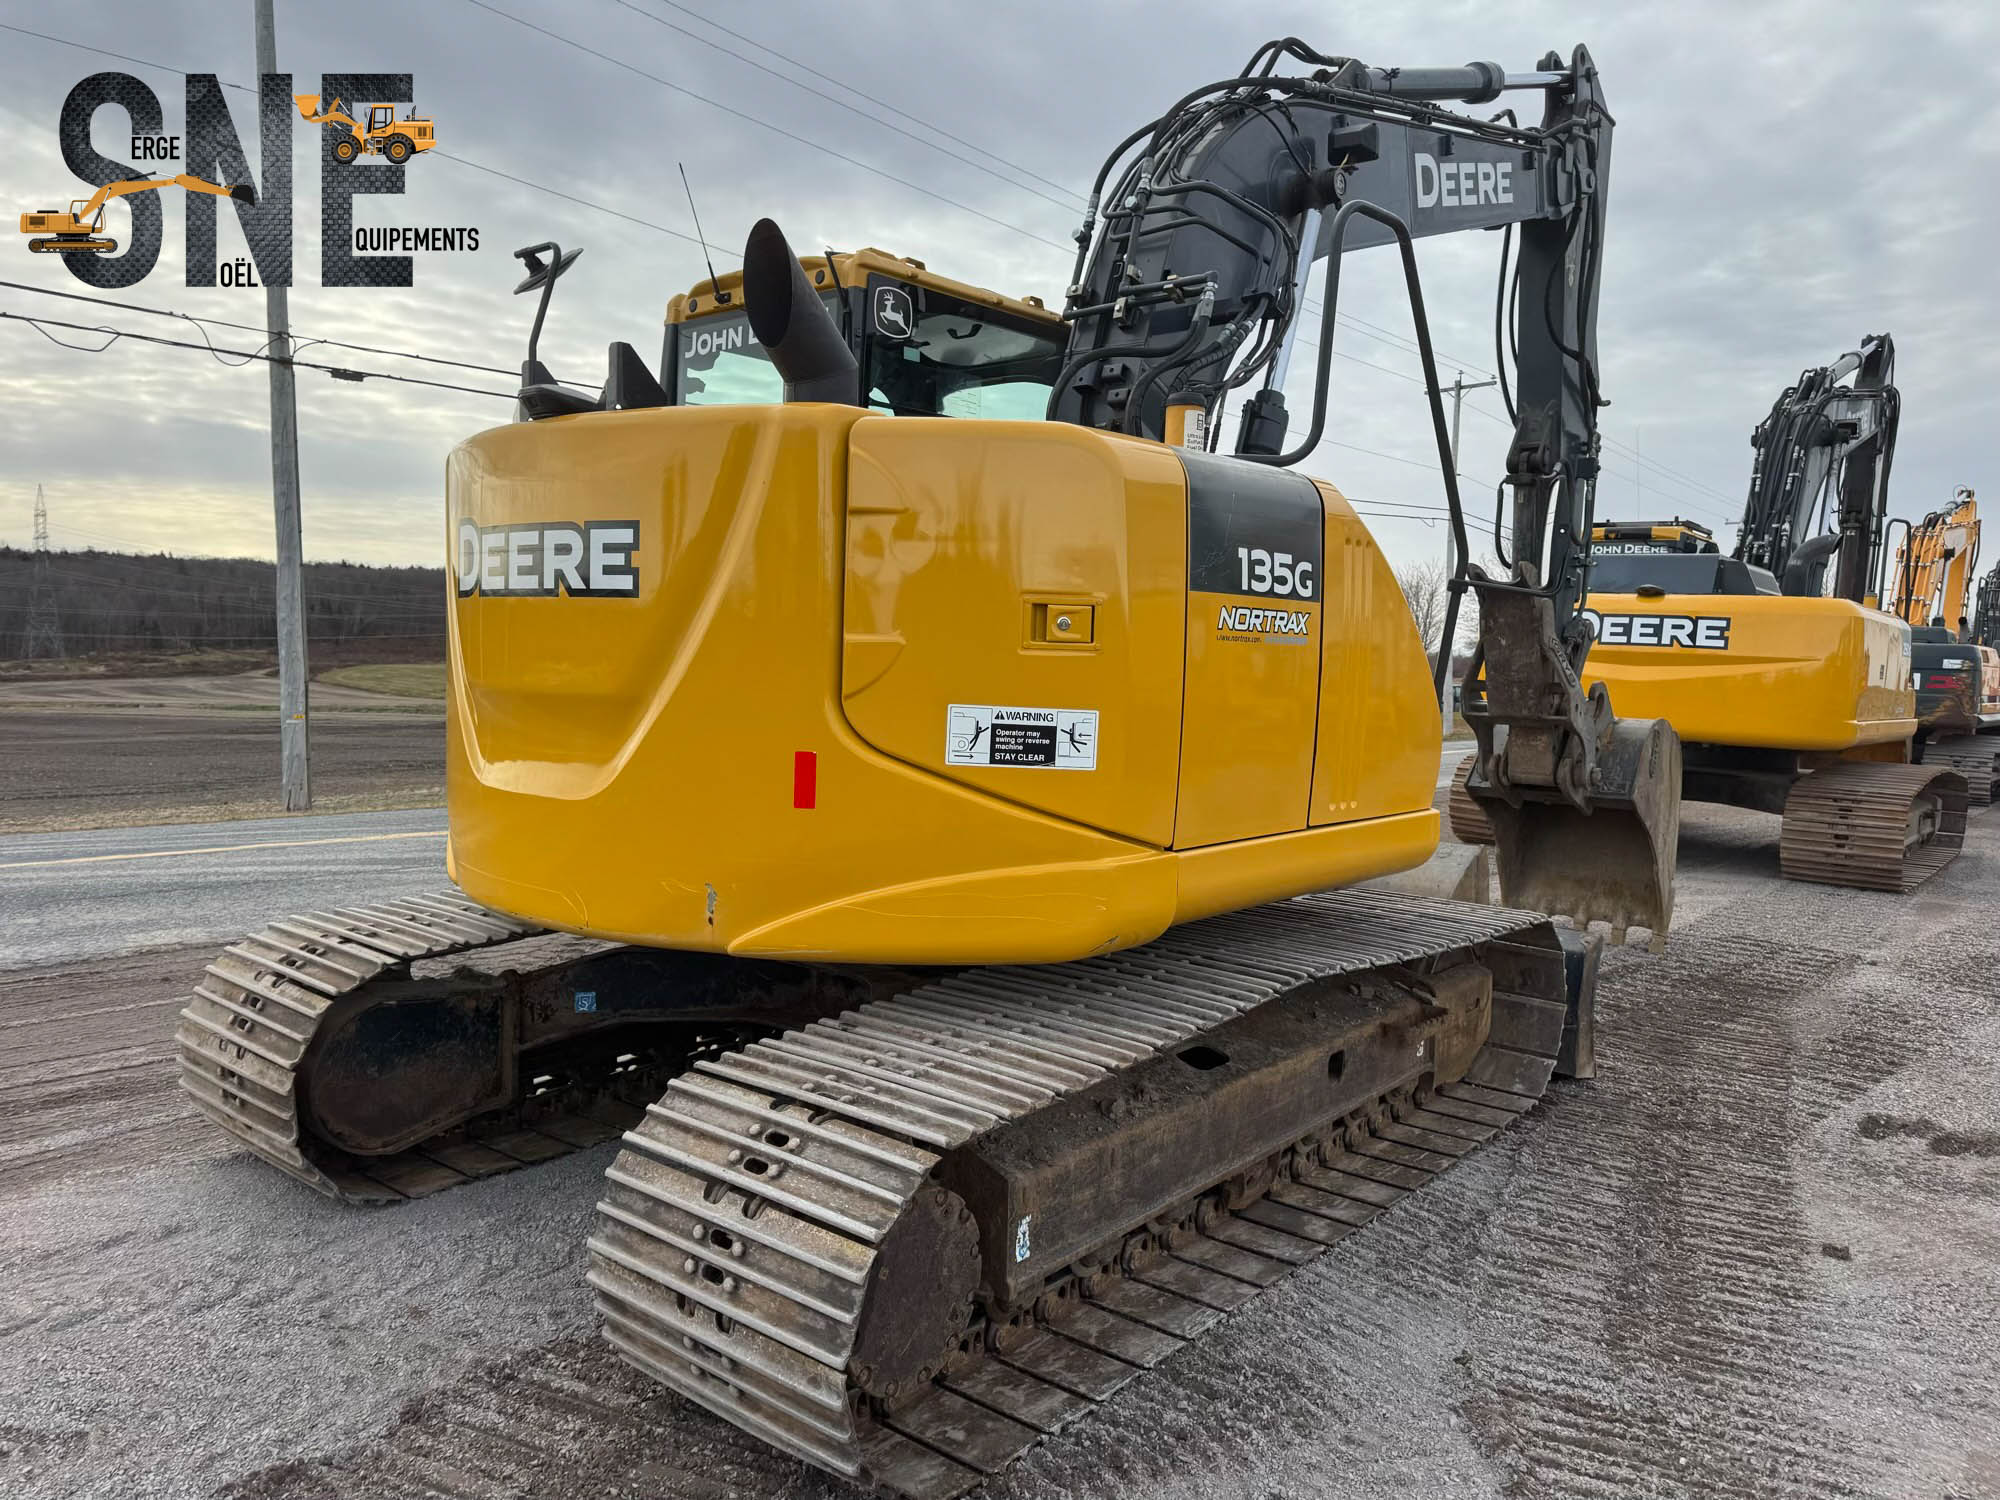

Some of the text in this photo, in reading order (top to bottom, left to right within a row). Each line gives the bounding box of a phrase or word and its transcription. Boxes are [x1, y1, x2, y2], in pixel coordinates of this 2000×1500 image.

[1414, 153, 1514, 208] DEERE
[684, 326, 743, 359] JOHN
[458, 522, 636, 592] DEERE
[1590, 543, 1669, 554] JOHN DEERE
[1238, 547, 1312, 598] 135G
[1217, 605, 1311, 635] NORTRAX
[1006, 711, 1054, 723] WARNING
[995, 729, 1025, 737] Operator
[994, 752, 1045, 762] STAY CLEAR
